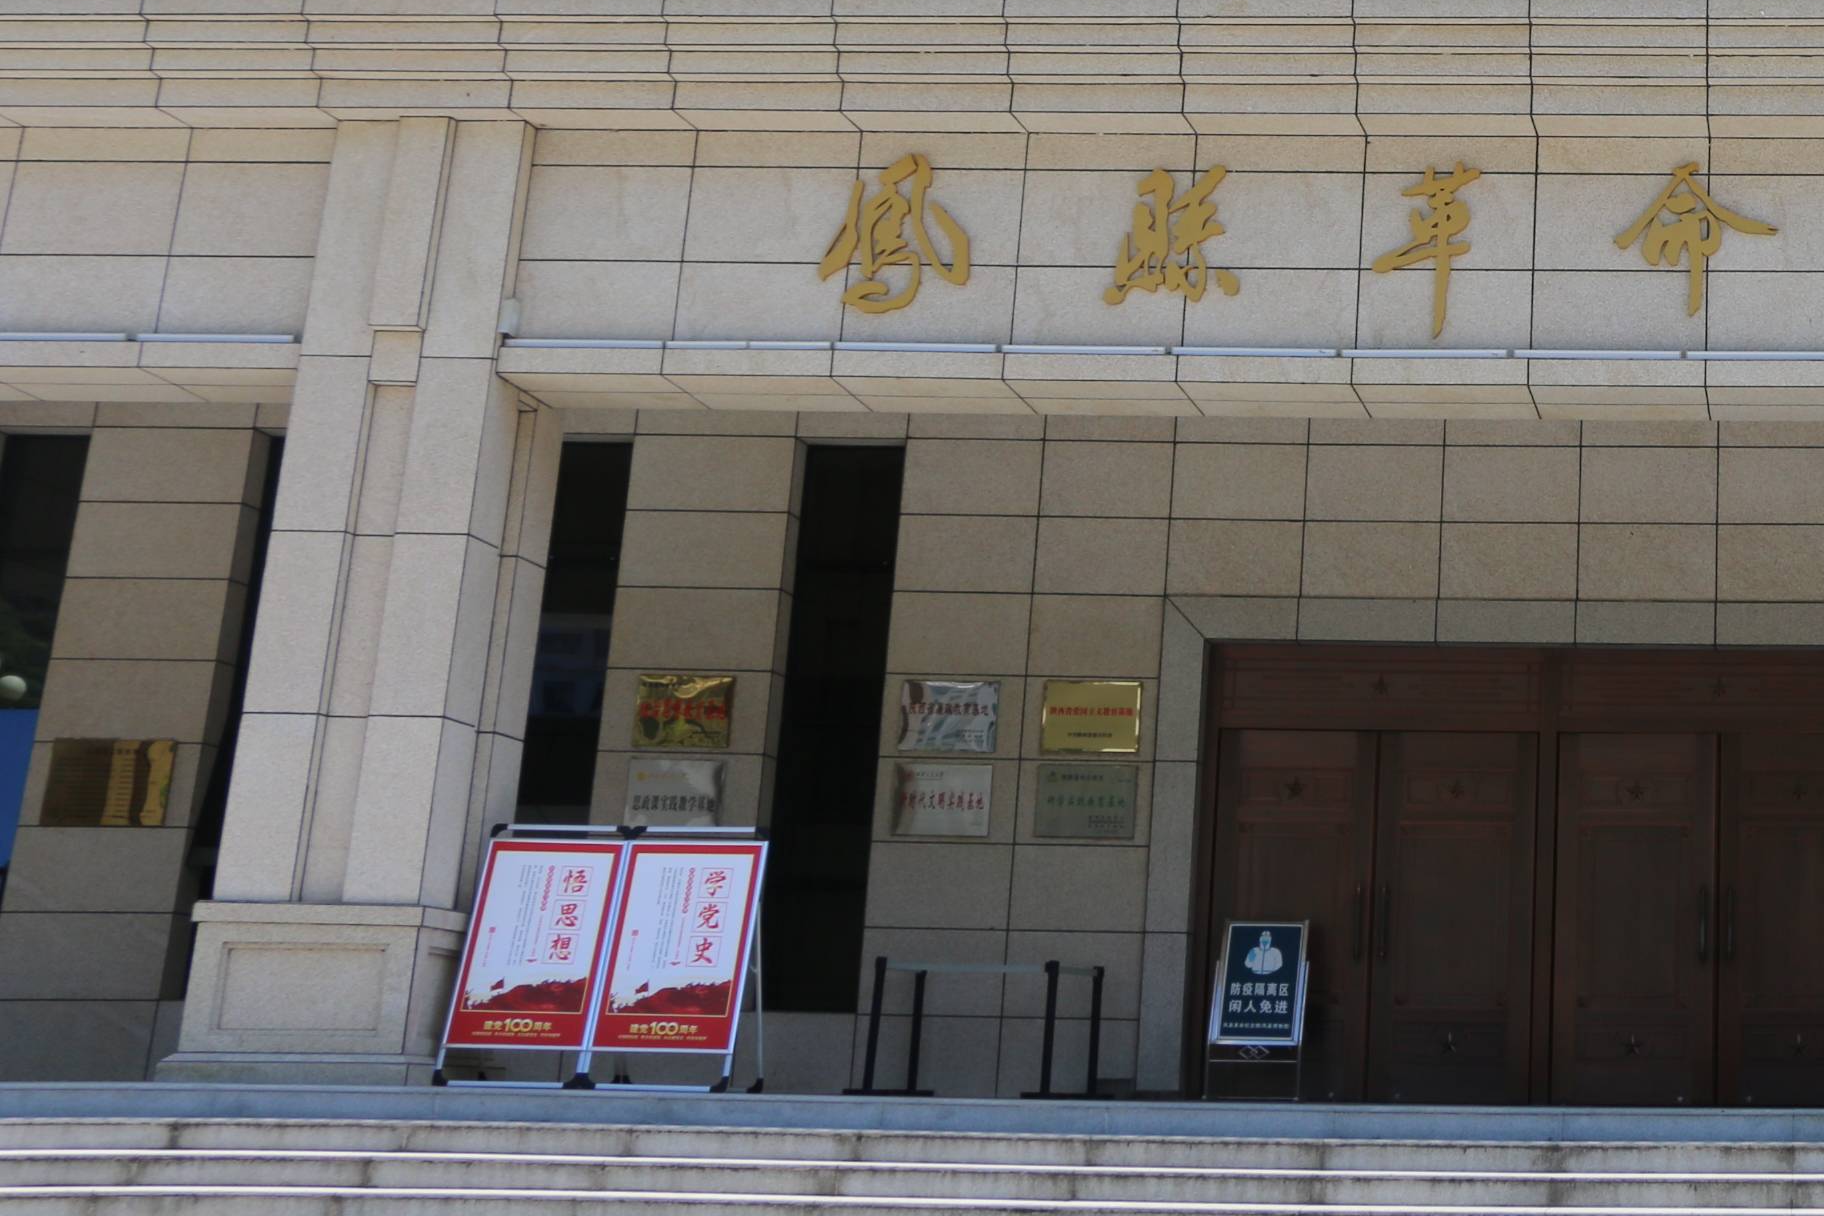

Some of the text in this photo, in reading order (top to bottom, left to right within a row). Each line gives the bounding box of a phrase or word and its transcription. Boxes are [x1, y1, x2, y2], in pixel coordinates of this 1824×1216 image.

[696, 870, 727, 965] 学党史
[1230, 982, 1289, 997] 防疫隔离区
[1228, 999, 1288, 1014] 闲人免进
[483, 1018, 553, 1033] 建党100周年
[629, 1021, 699, 1035] 建党100周年
